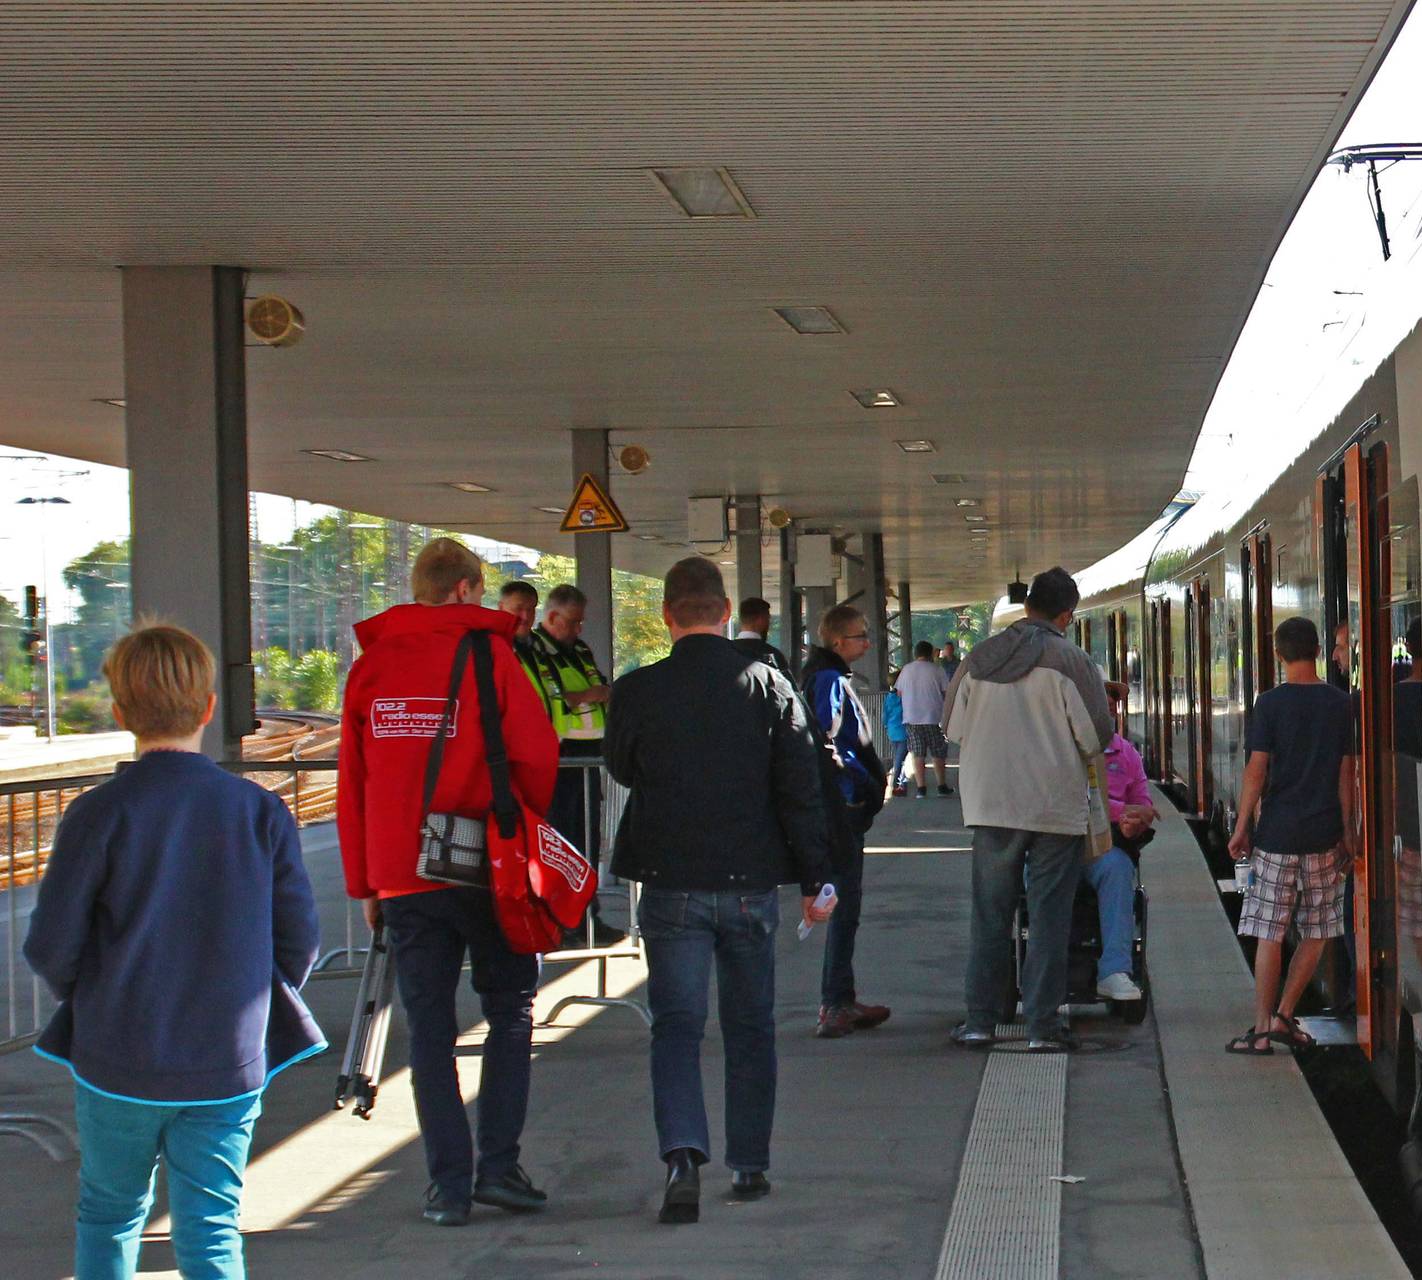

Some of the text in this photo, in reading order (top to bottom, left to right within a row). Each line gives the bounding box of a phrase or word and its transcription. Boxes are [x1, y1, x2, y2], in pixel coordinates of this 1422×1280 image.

[375, 702, 406, 711] 102.2
[381, 711, 411, 720] radio
[545, 842, 569, 858] radio
